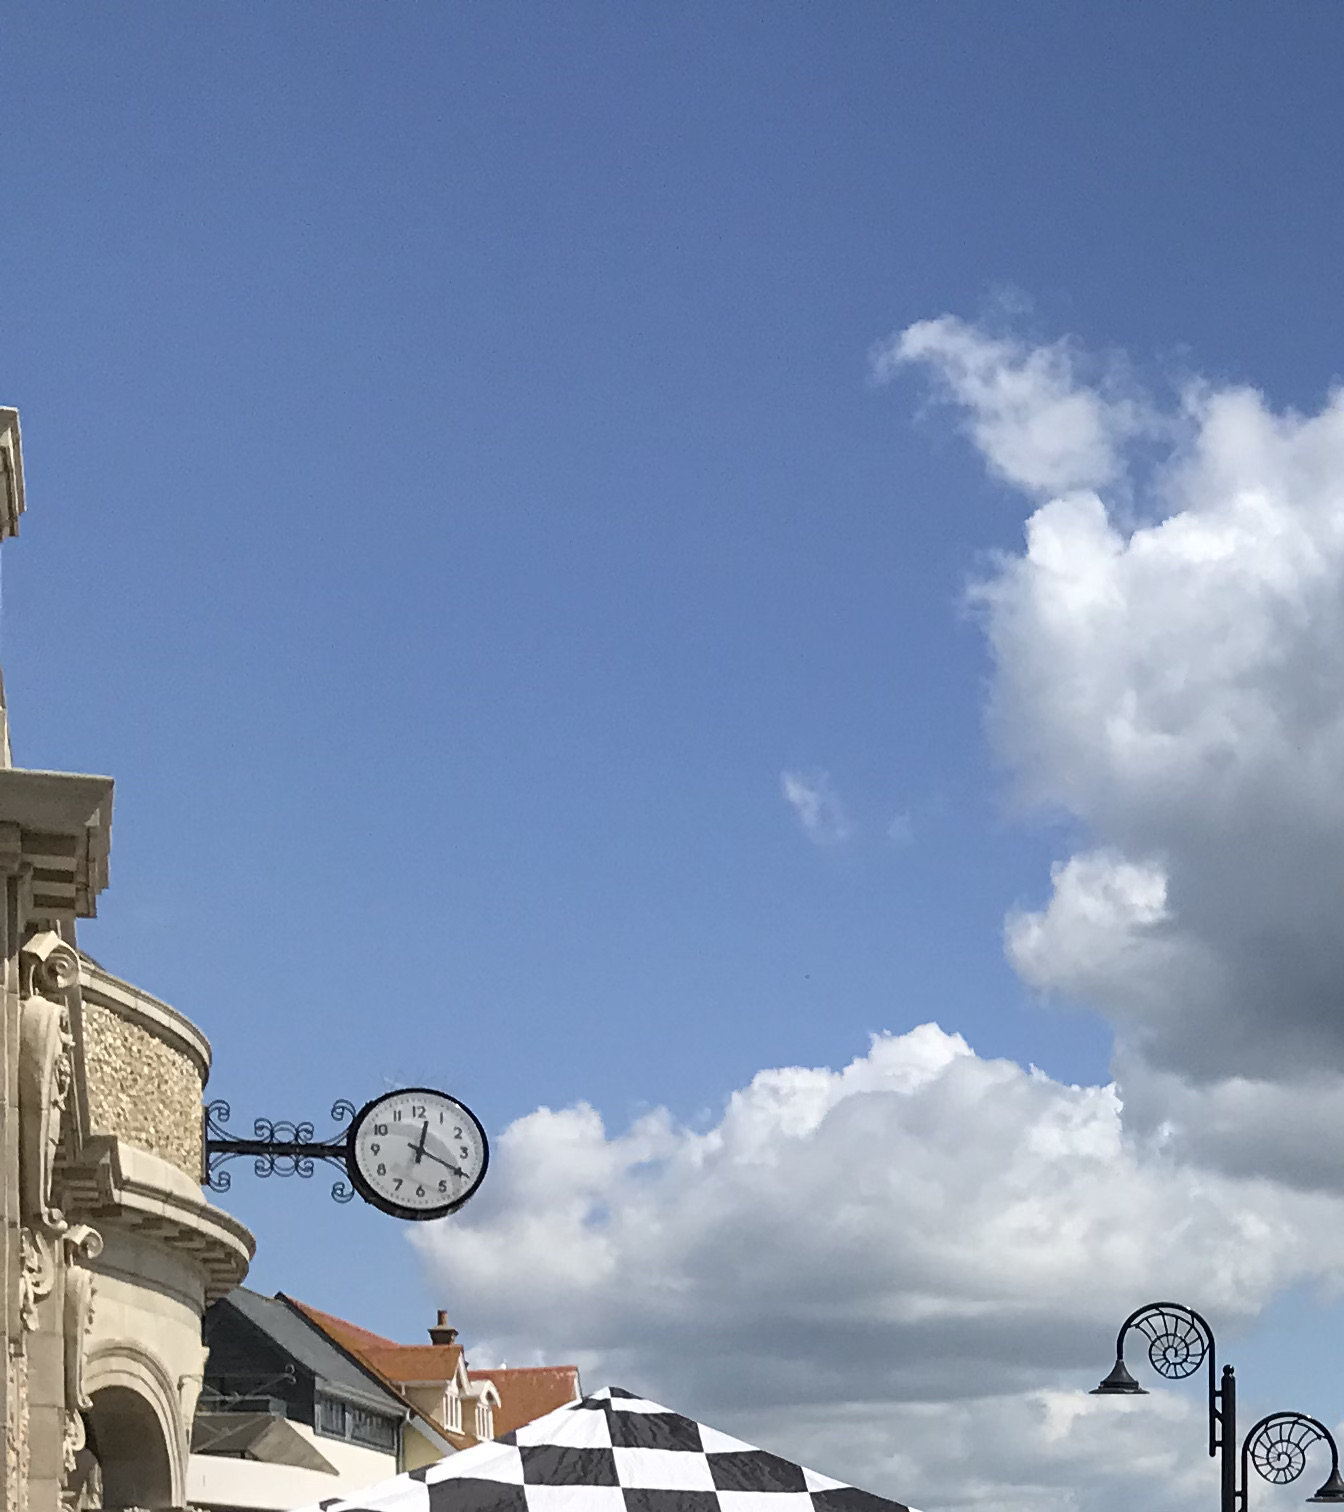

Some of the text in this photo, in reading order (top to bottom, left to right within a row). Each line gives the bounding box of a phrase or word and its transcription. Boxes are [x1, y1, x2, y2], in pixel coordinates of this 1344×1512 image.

[393, 1110, 402, 1122] 11
[412, 1105, 427, 1119] 12
[439, 1112, 444, 1125] 1
[374, 1124, 388, 1136] 10
[453, 1127, 463, 1139] 2
[370, 1143, 380, 1156] 9
[460, 1146, 468, 1159] 3
[377, 1163, 386, 1176] 8
[393, 1178, 403, 1191] 7
[416, 1185, 425, 1197] 6
[438, 1180, 447, 1193] 5
